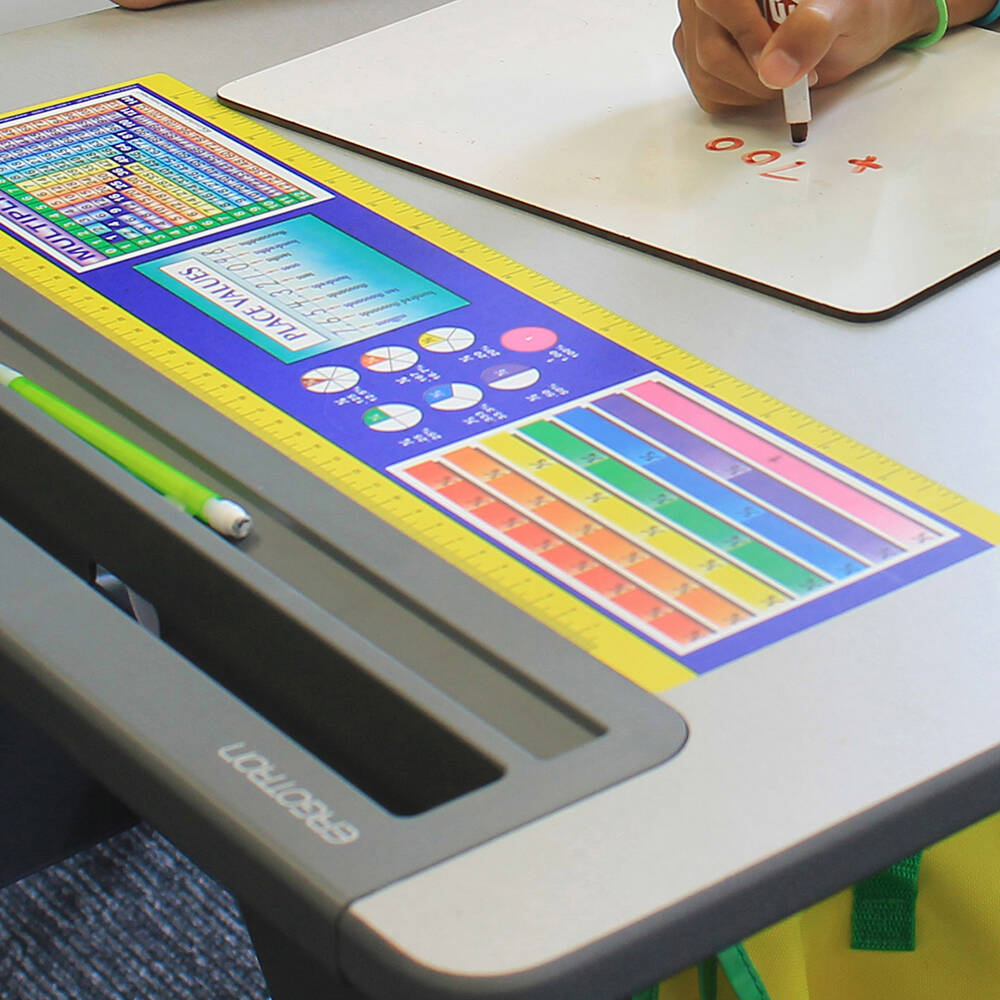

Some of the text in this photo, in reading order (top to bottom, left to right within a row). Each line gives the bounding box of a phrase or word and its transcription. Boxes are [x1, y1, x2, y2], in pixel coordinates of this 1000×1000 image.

[81, 176, 98, 184] 24
[110, 180, 128, 188] 25
[49, 185, 66, 193] 12
[141, 184, 158, 192] 24
[78, 189, 96, 197] 15
[109, 193, 126, 201] 16
[93, 197, 110, 205] 12
[124, 201, 141, 209] 12
[139, 197, 157, 205] 15
[170, 201, 187, 209] 12
[0, 196, 96, 260] MULTIPL
[178, 266, 308, 341] PLACE VALUES
